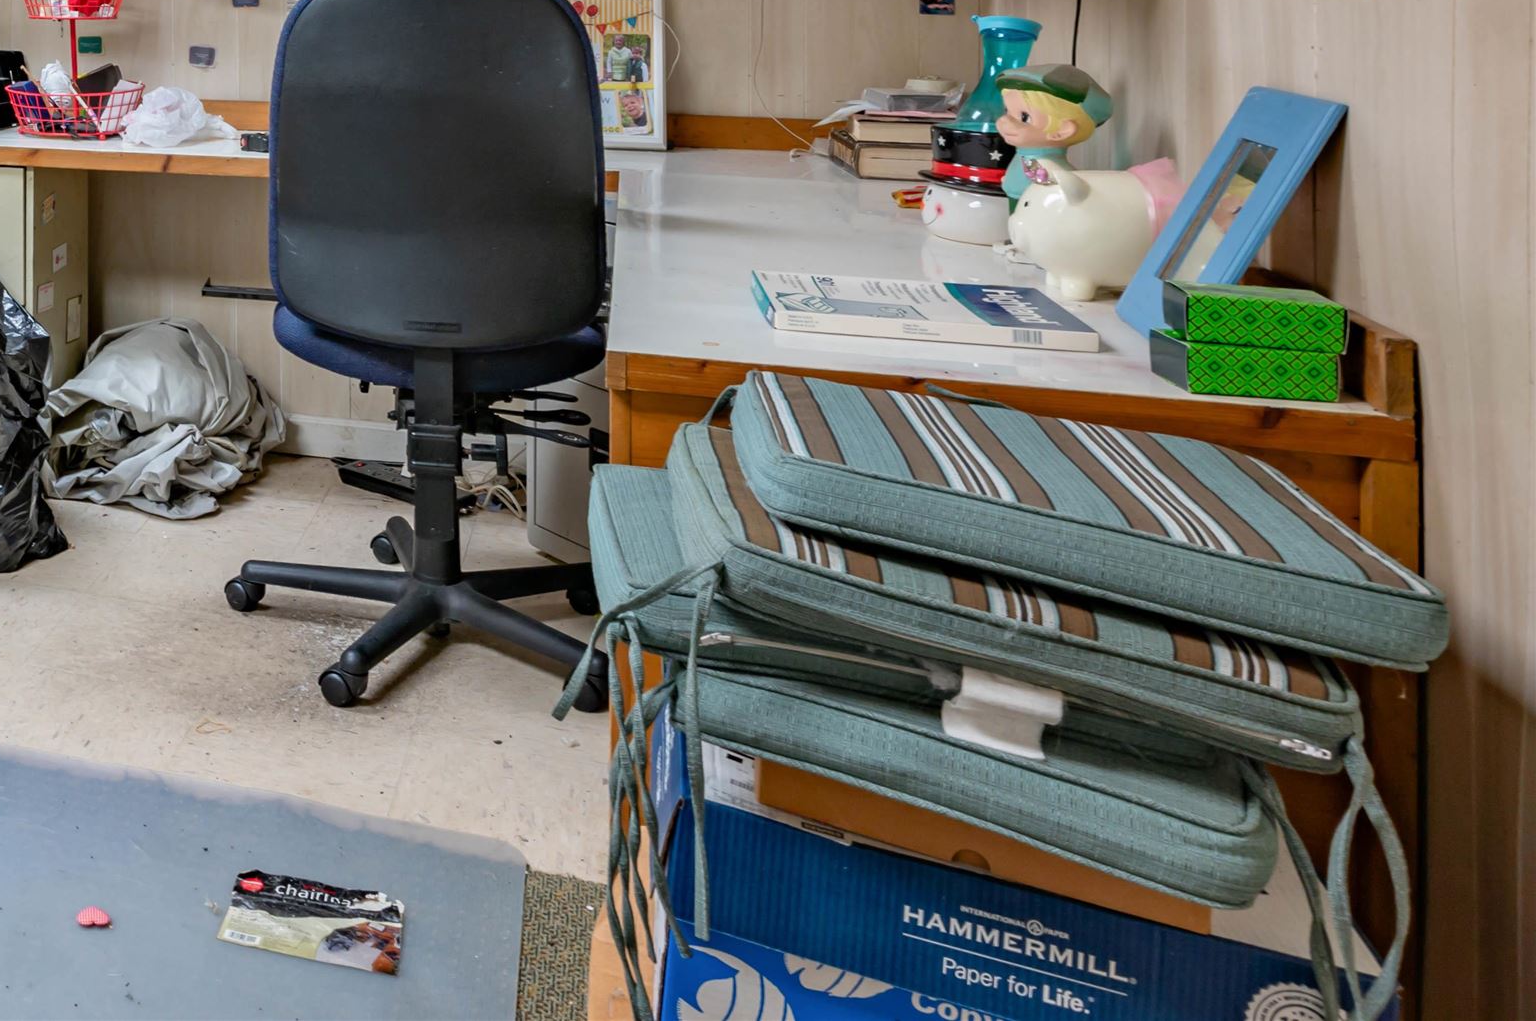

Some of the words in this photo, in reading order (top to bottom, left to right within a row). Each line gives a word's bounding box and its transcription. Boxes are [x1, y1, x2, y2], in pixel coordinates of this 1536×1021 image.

[981, 288, 1062, 326] Highland
[960, 905, 1027, 929] INTERNATIONAL
[1044, 927, 1070, 940] PAPER
[942, 957, 1002, 986] Paper
[1007, 975, 1037, 999] for
